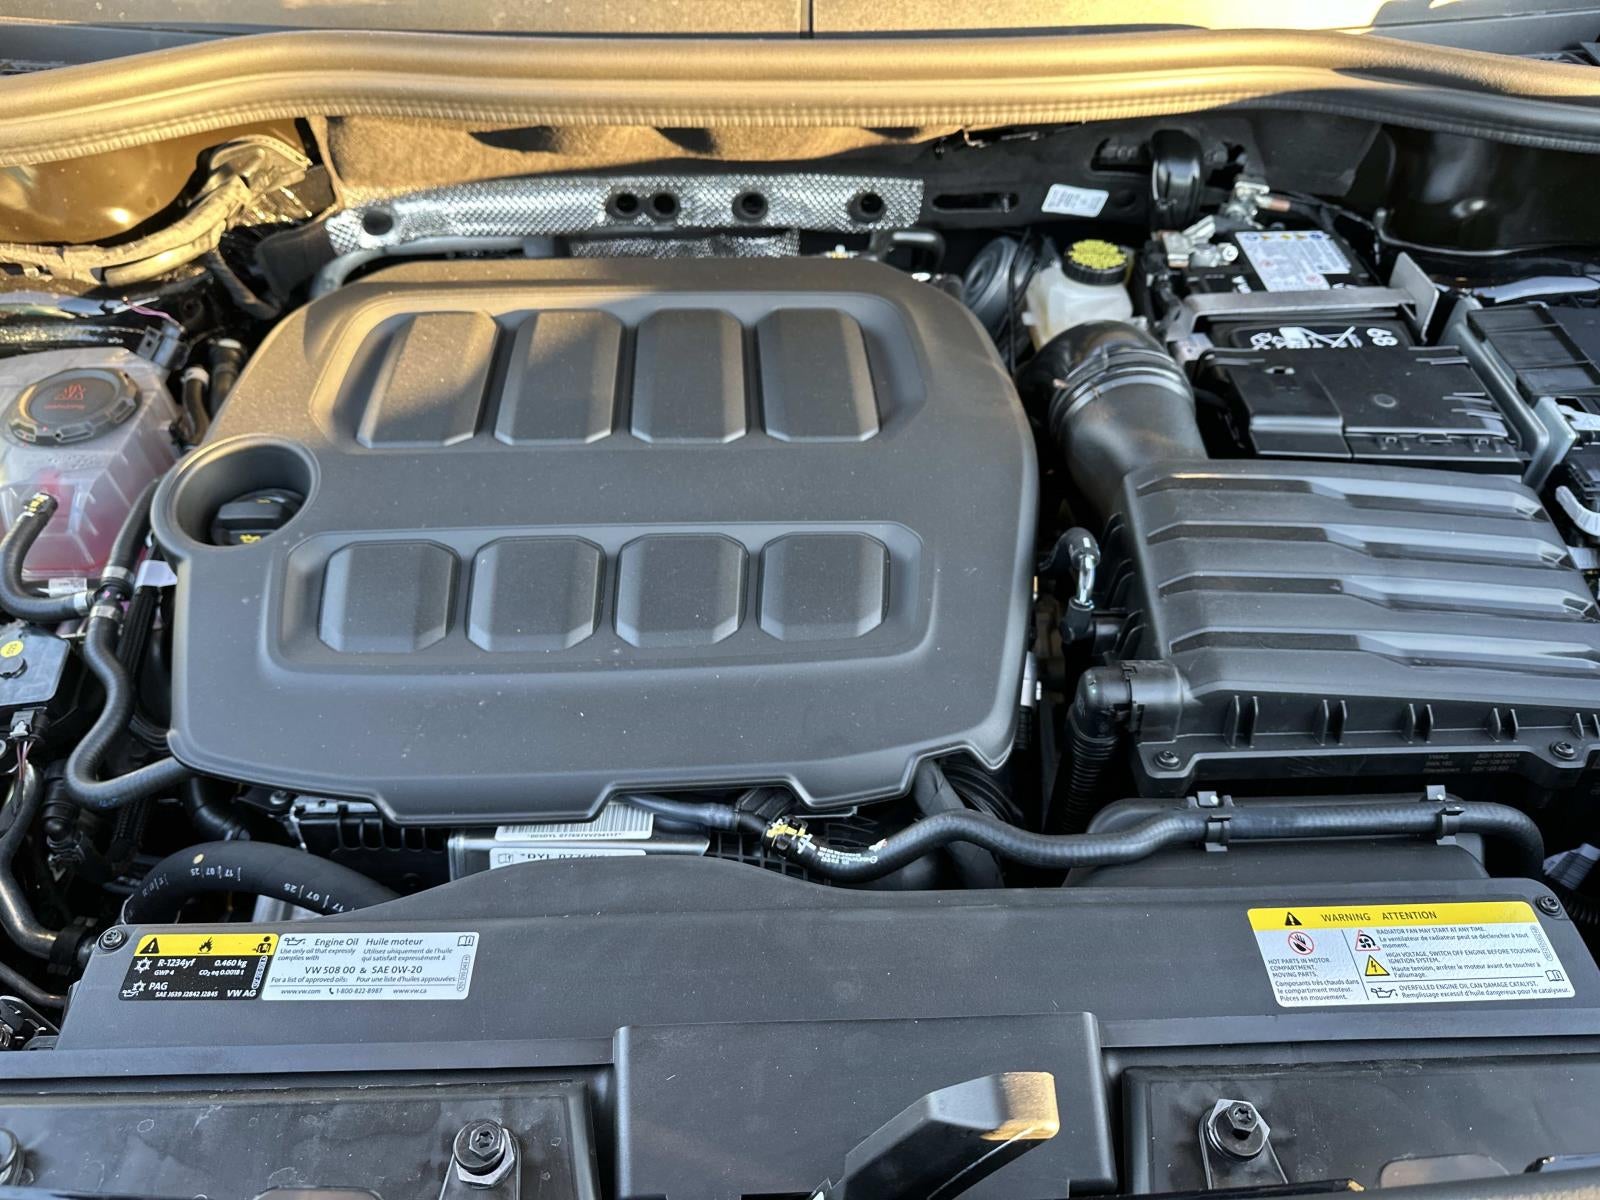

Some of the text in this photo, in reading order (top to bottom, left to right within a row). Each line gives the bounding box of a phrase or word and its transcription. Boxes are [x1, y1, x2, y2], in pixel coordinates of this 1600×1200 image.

[1321, 911, 1437, 922] WARNING ATTENTION
[315, 938, 344, 948] Engine
[157, 958, 248, 969] R-1234yf 0.460 kg
[342, 966, 356, 974] 00
[392, 966, 423, 974] 0W-20
[148, 982, 168, 990] PAG
[1275, 980, 1311, 988] Composants
